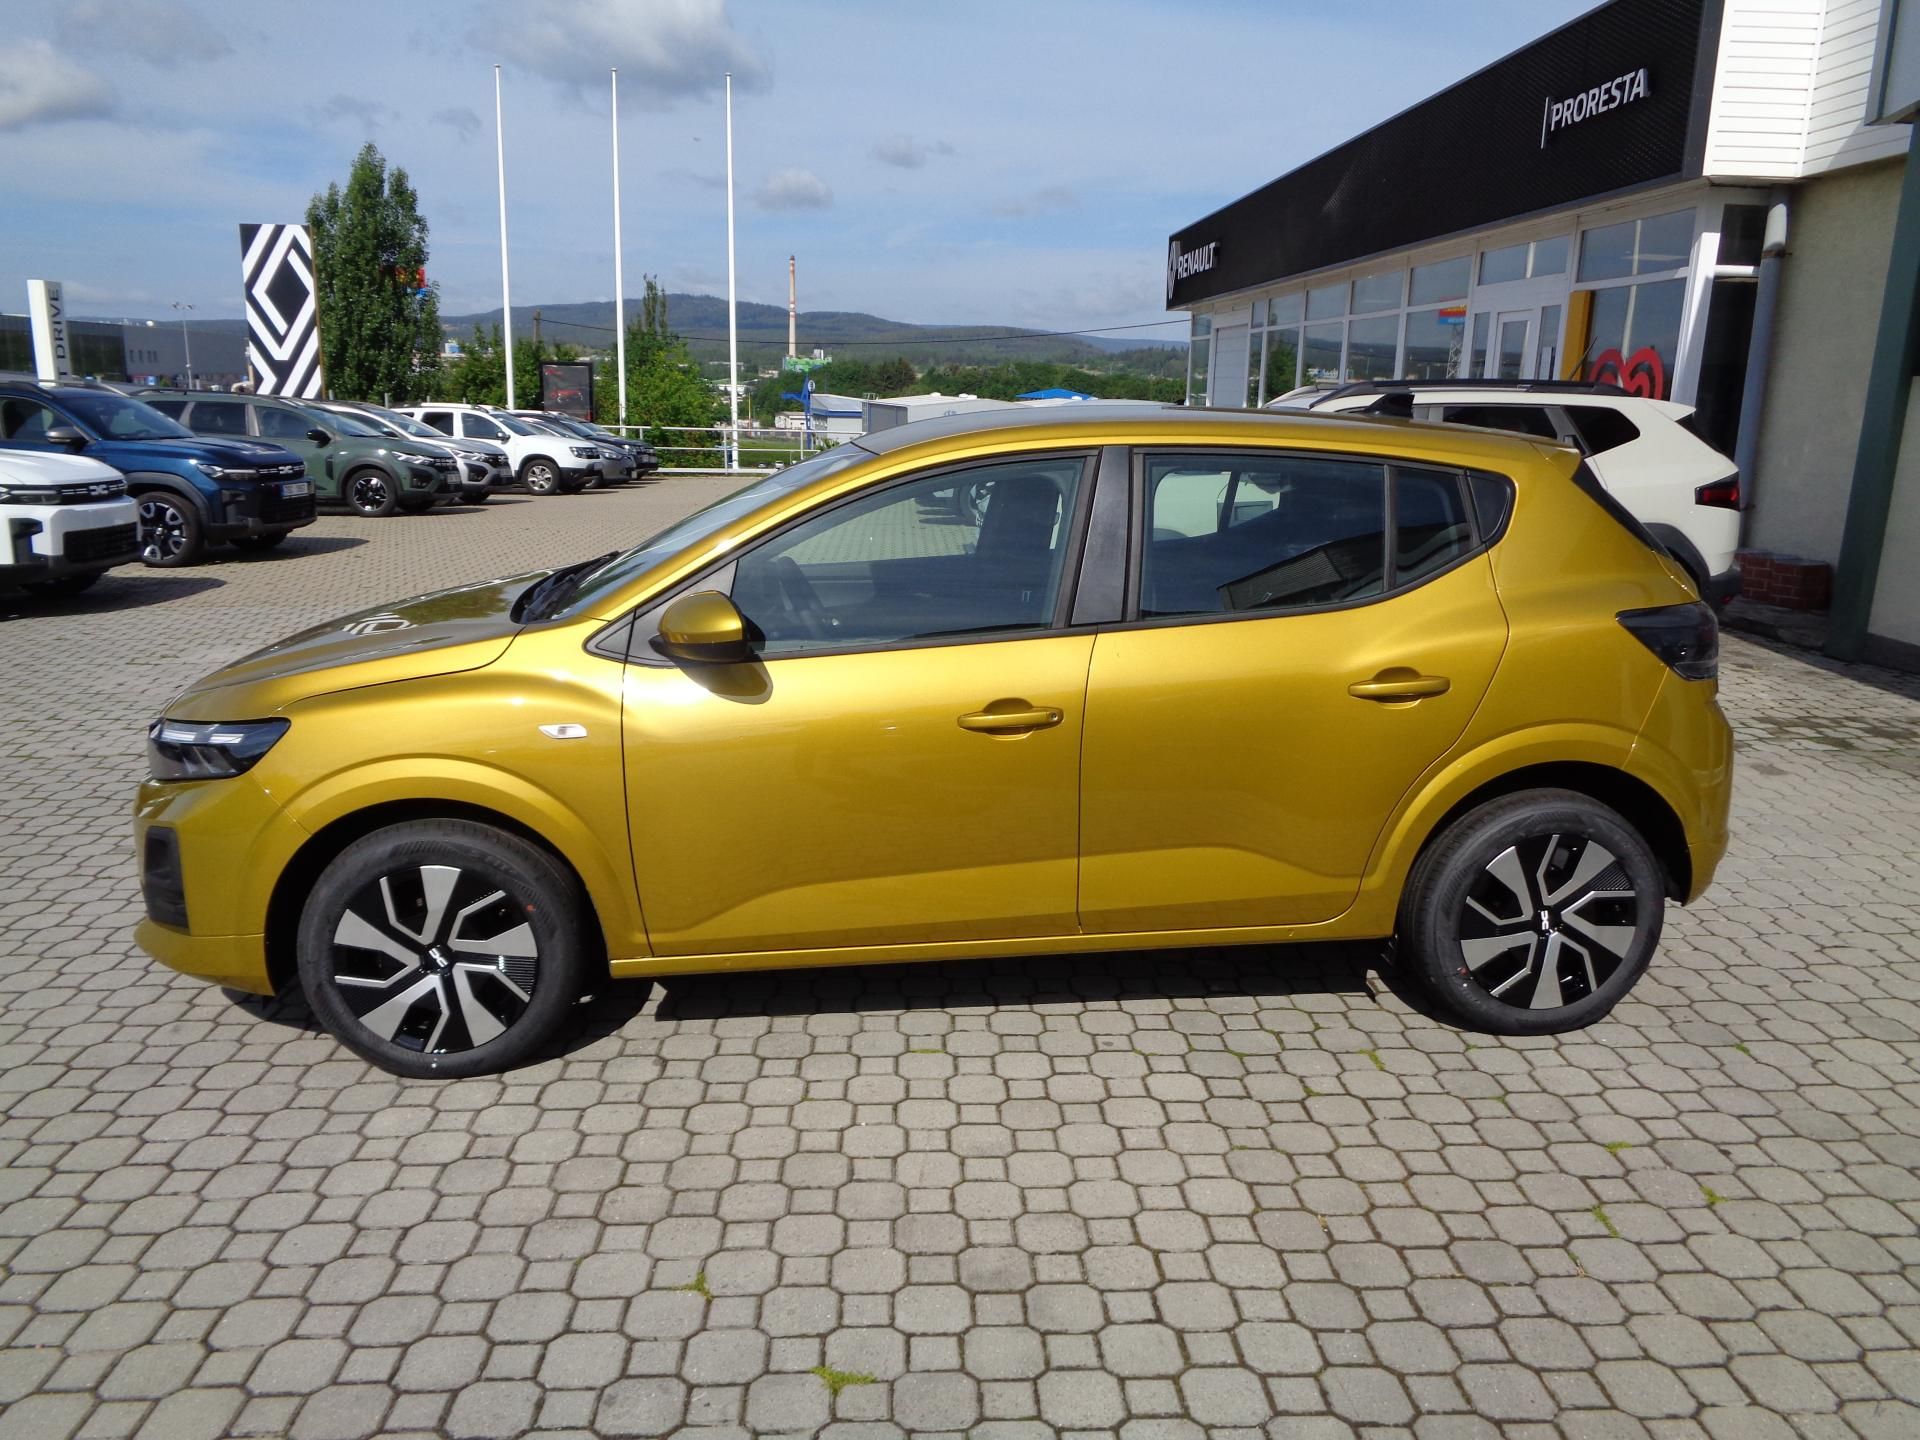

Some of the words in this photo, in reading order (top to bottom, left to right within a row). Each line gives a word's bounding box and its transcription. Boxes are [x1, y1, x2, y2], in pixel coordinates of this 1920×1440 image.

[1550, 68, 1649, 132] PRORESTA
[1177, 241, 1216, 280] RENAULT
[48, 287, 67, 359] DRIVE
